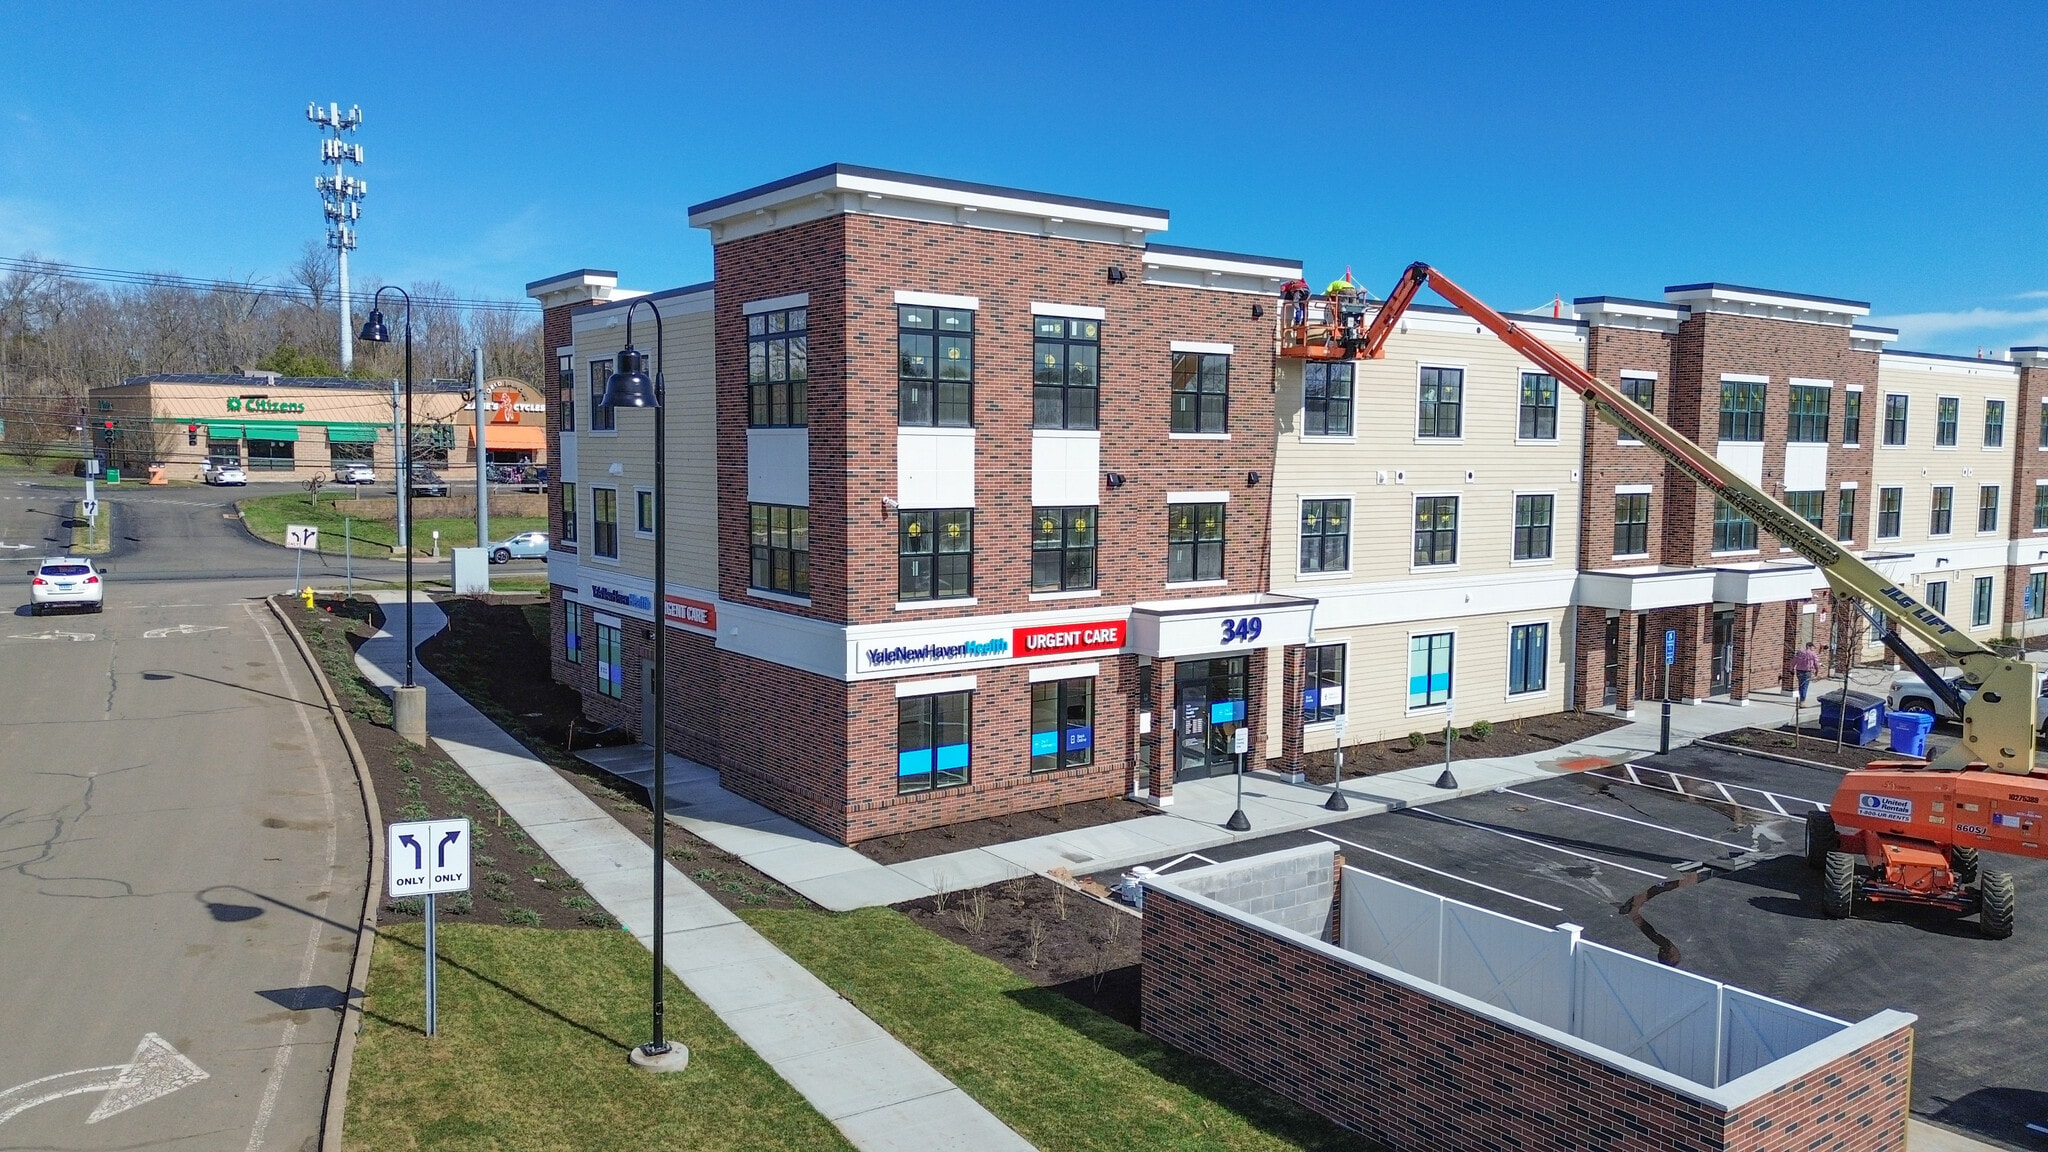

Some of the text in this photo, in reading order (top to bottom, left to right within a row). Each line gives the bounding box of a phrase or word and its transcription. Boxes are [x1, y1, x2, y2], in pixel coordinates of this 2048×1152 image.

[246, 398, 305, 412] Citizens
[464, 402, 545, 412] ZE'S CYCLES
[665, 602, 709, 624] GENT CARE
[1880, 586, 1956, 634] JLG LIFT
[1220, 616, 1262, 644] 349
[1026, 628, 1118, 650] URGENT CARE
[867, 638, 1008, 665] YaleNewHavenHealth
[1881, 803, 1909, 813] Rentals
[1882, 798, 1908, 807] United
[1859, 810, 1910, 821] 1-800-UR-RENTS
[1956, 824, 1987, 835] 860SJ
[396, 873, 463, 886] ONLY ONLY
